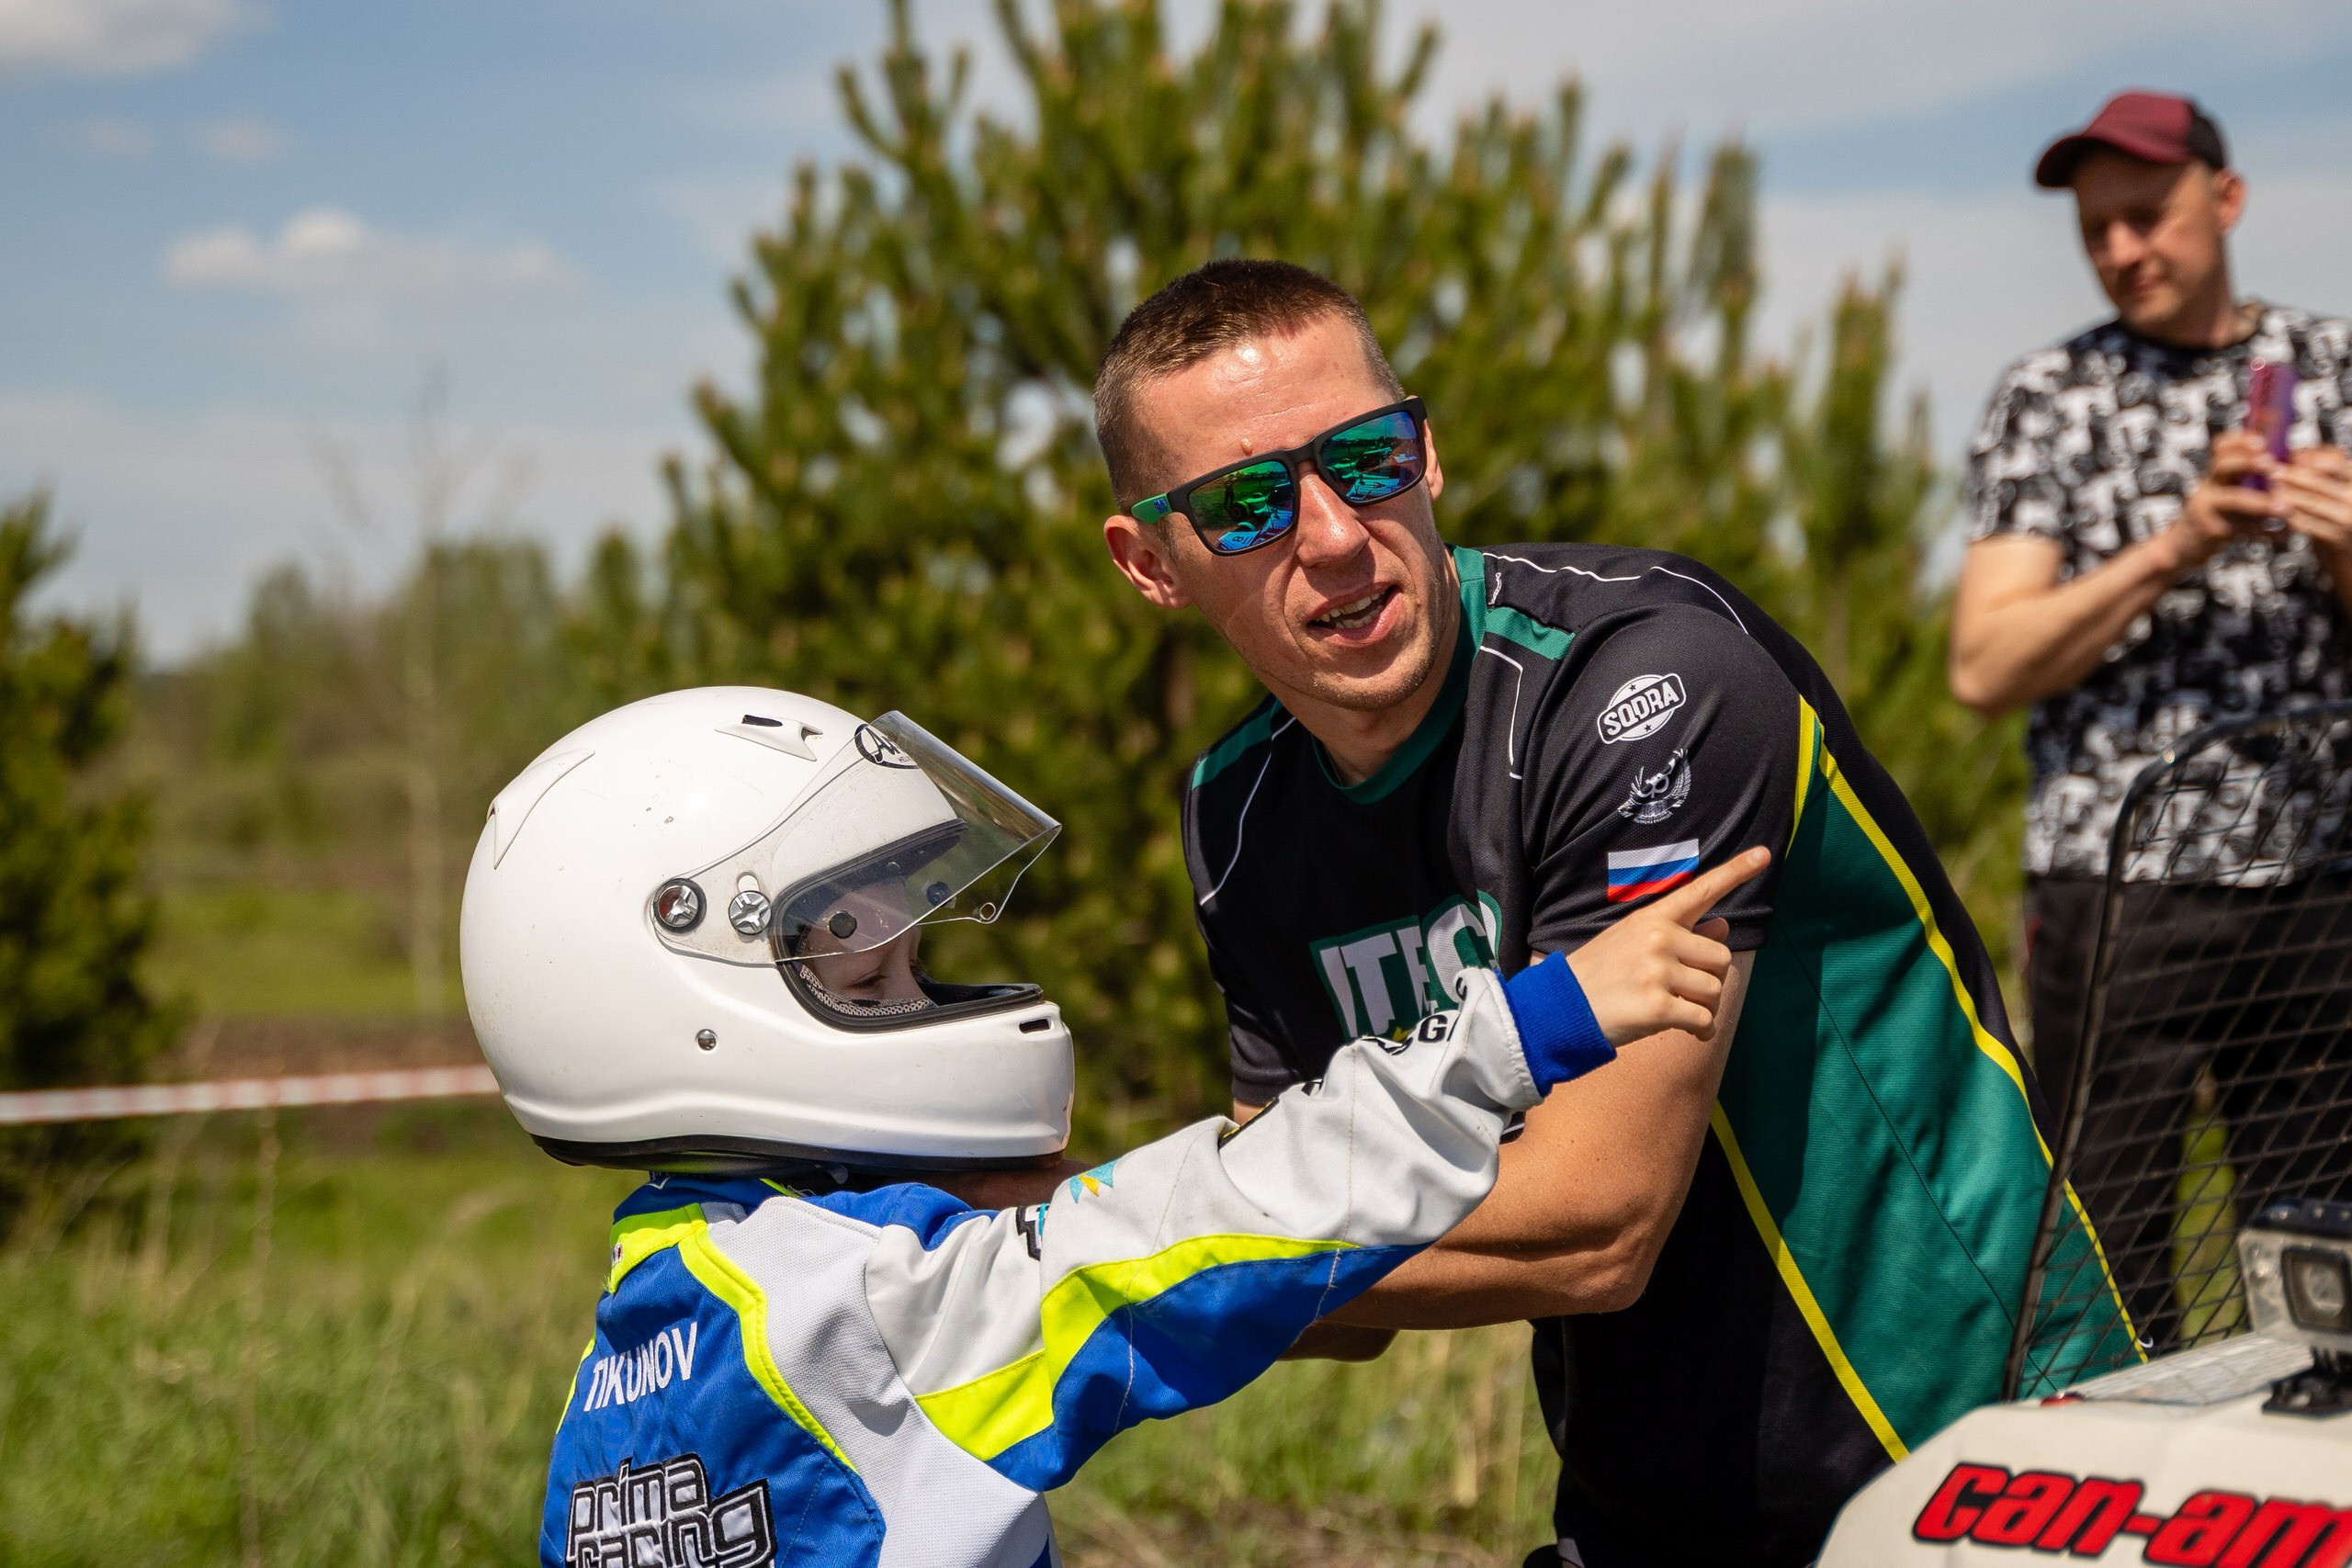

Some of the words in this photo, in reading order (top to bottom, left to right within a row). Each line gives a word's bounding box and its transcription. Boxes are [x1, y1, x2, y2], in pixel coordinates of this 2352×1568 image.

[582, 1321, 698, 1412] TIKUNOV
[567, 1456, 709, 1563] prima
[571, 1482, 775, 1568] racing
[1913, 1461, 2352, 1568] can-am
